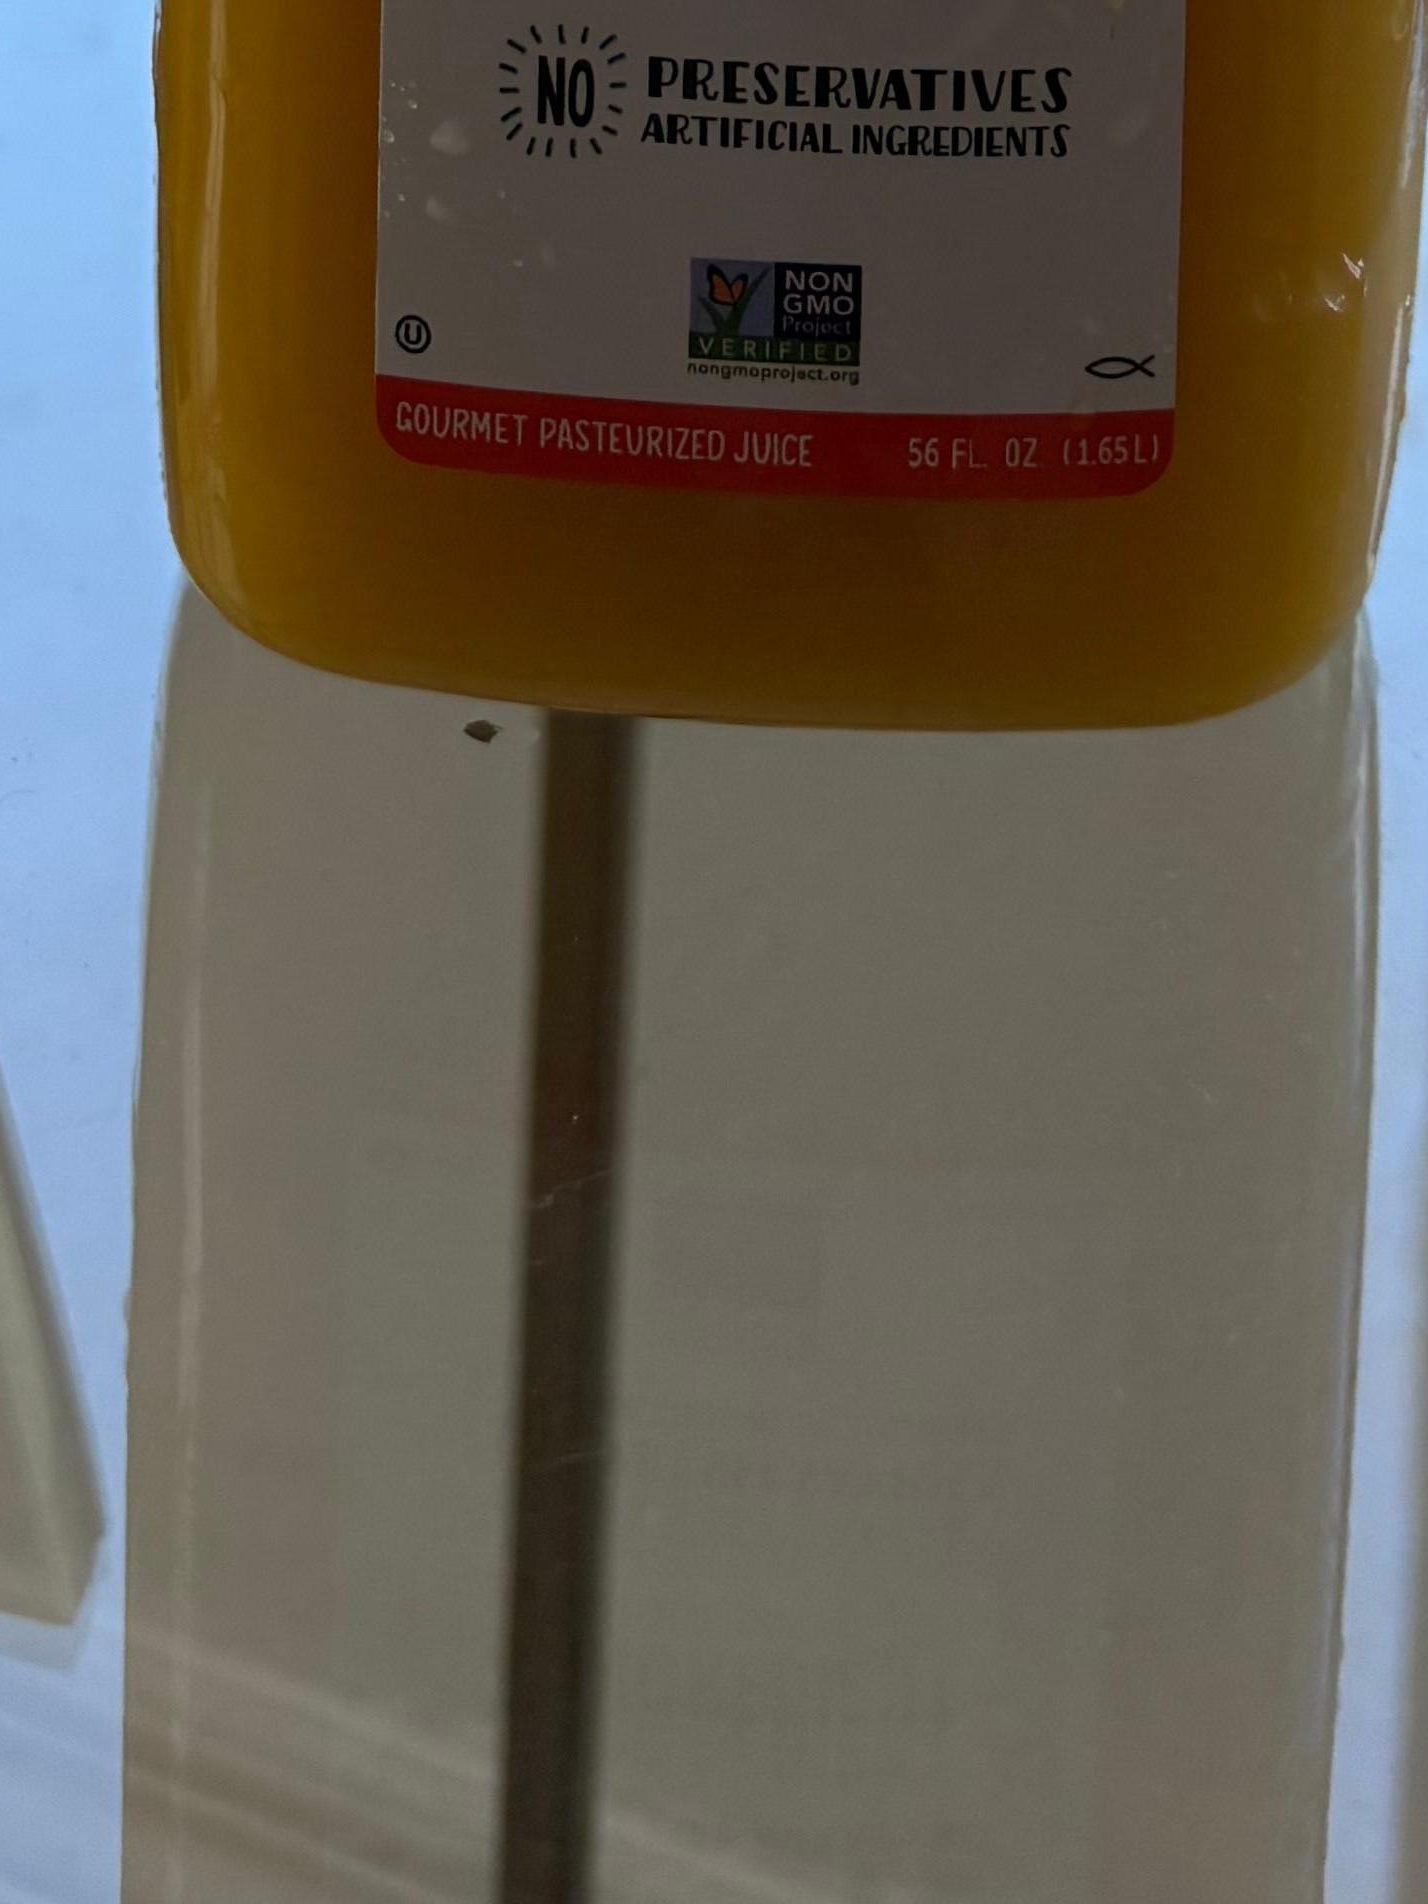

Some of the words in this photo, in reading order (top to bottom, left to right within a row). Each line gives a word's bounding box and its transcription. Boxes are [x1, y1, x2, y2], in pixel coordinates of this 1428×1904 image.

[536, 55, 596, 128] NO
[647, 55, 1073, 115] PRESERVATIVES
[640, 112, 844, 155] ARTIFICIAL
[851, 123, 1070, 158] INGREDIENTS
[784, 269, 854, 293] NON
[782, 293, 855, 316] GMO
[782, 315, 852, 337] Project
[697, 337, 853, 362] VERIFIED
[686, 362, 861, 386] nongmoproject.org
[394, 400, 529, 447] GOURMET
[539, 417, 726, 462] PASTEURIZED
[732, 432, 814, 468] JUICE
[907, 436, 940, 469] 56
